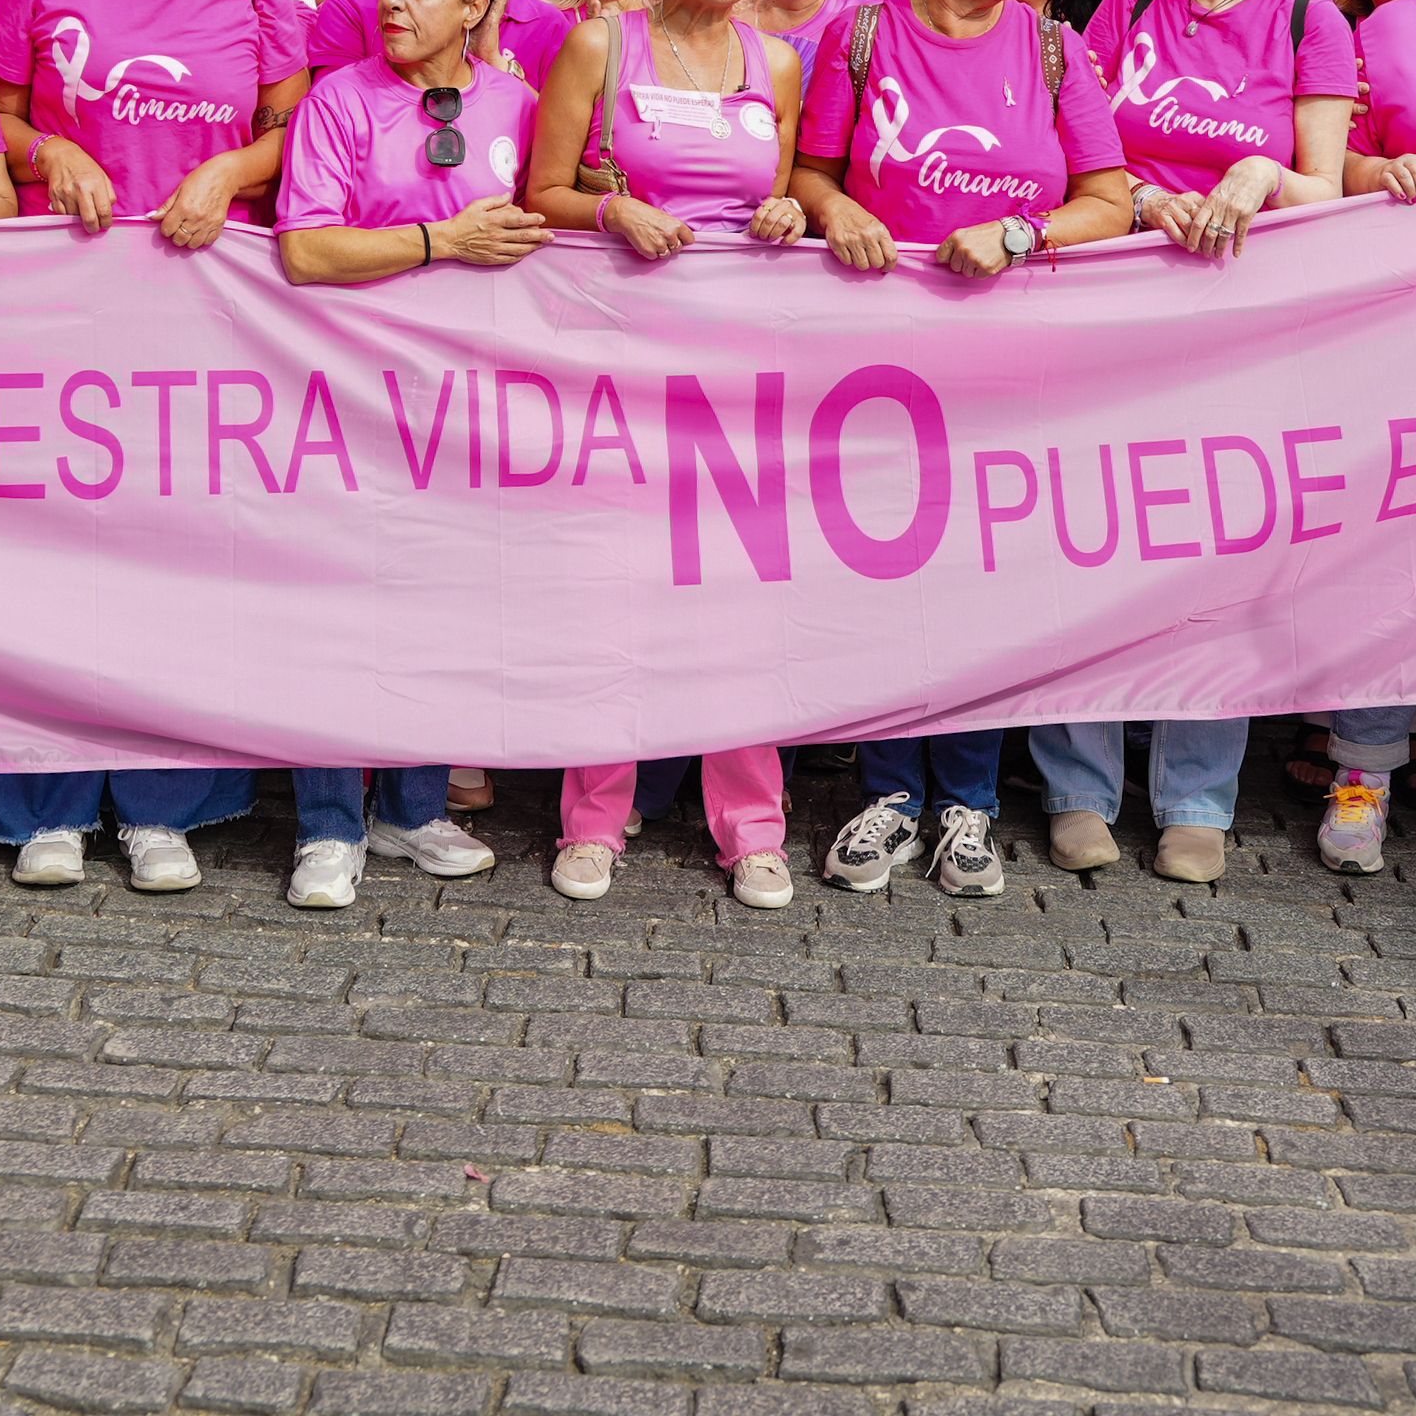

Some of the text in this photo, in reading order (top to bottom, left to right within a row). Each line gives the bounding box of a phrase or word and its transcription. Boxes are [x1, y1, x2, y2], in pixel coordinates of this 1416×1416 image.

[112, 83, 239, 125] Amama
[1149, 96, 1270, 147] Amama
[918, 150, 1044, 202] Amama
[381, 369, 646, 490] VIDA
[665, 364, 951, 587] NO
[973, 425, 1346, 572] PUEDE
